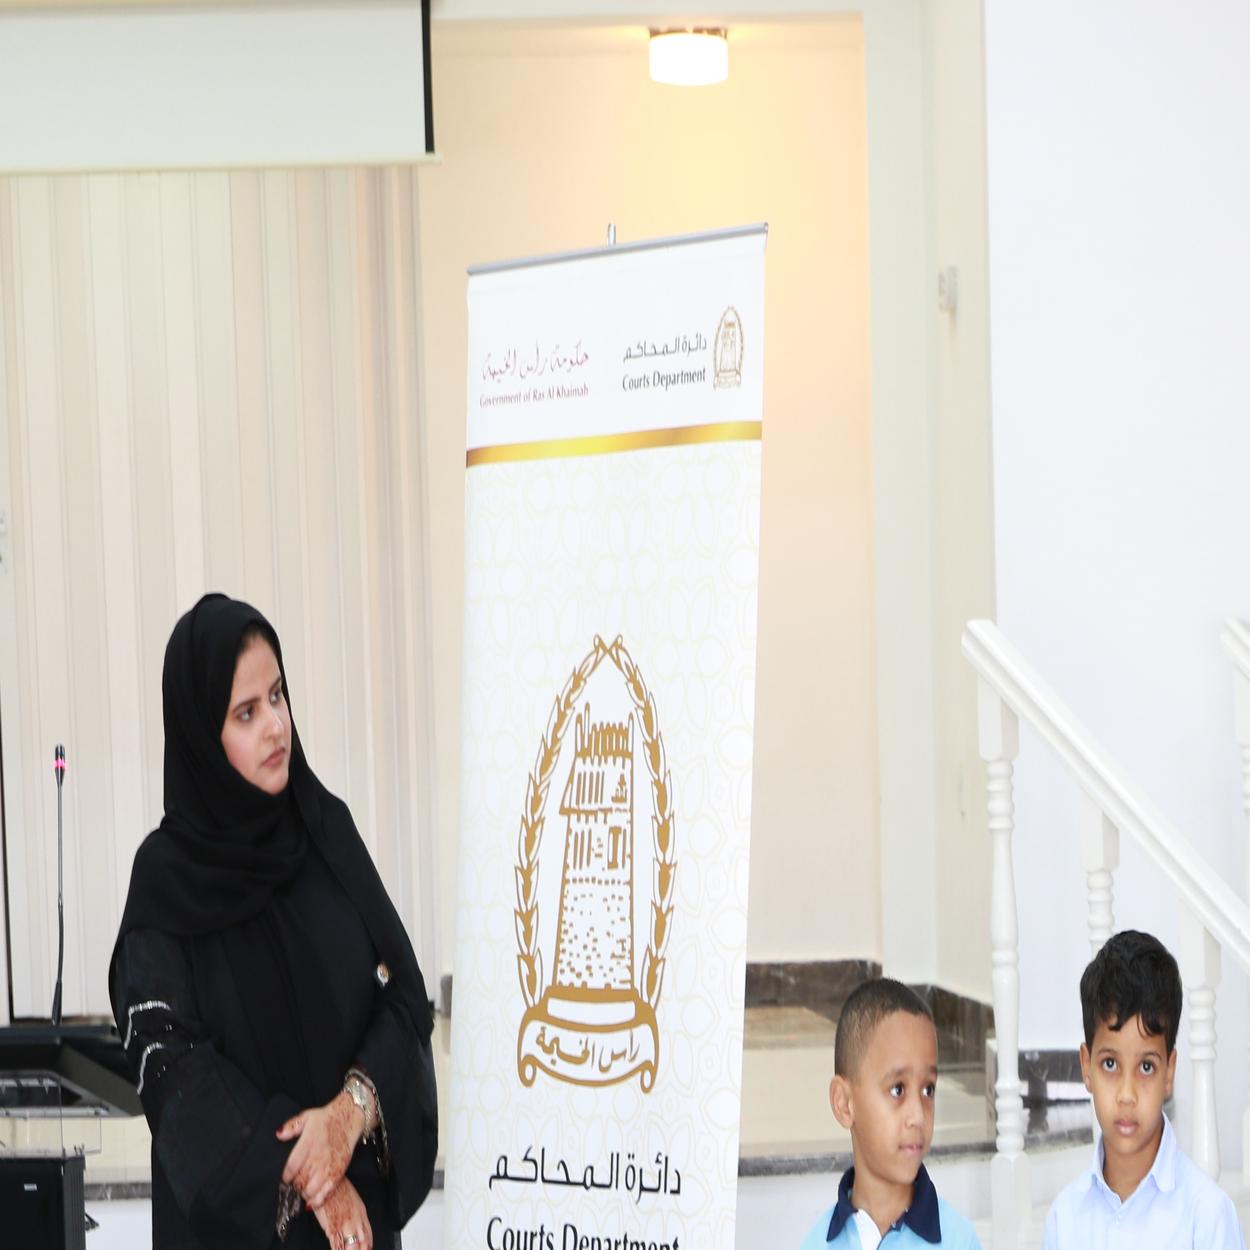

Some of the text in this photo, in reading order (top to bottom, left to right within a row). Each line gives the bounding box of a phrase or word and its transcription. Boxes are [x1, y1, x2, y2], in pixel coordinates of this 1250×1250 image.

[622, 331, 707, 364] دائرة المحاكم
[479, 381, 589, 408] Government of Ras Al Khaimah
[622, 373, 650, 392] Courts
[652, 367, 706, 391] Department
[535, 1026, 596, 1070] الخيمة
[488, 1145, 682, 1205] دائرة المحاكم
